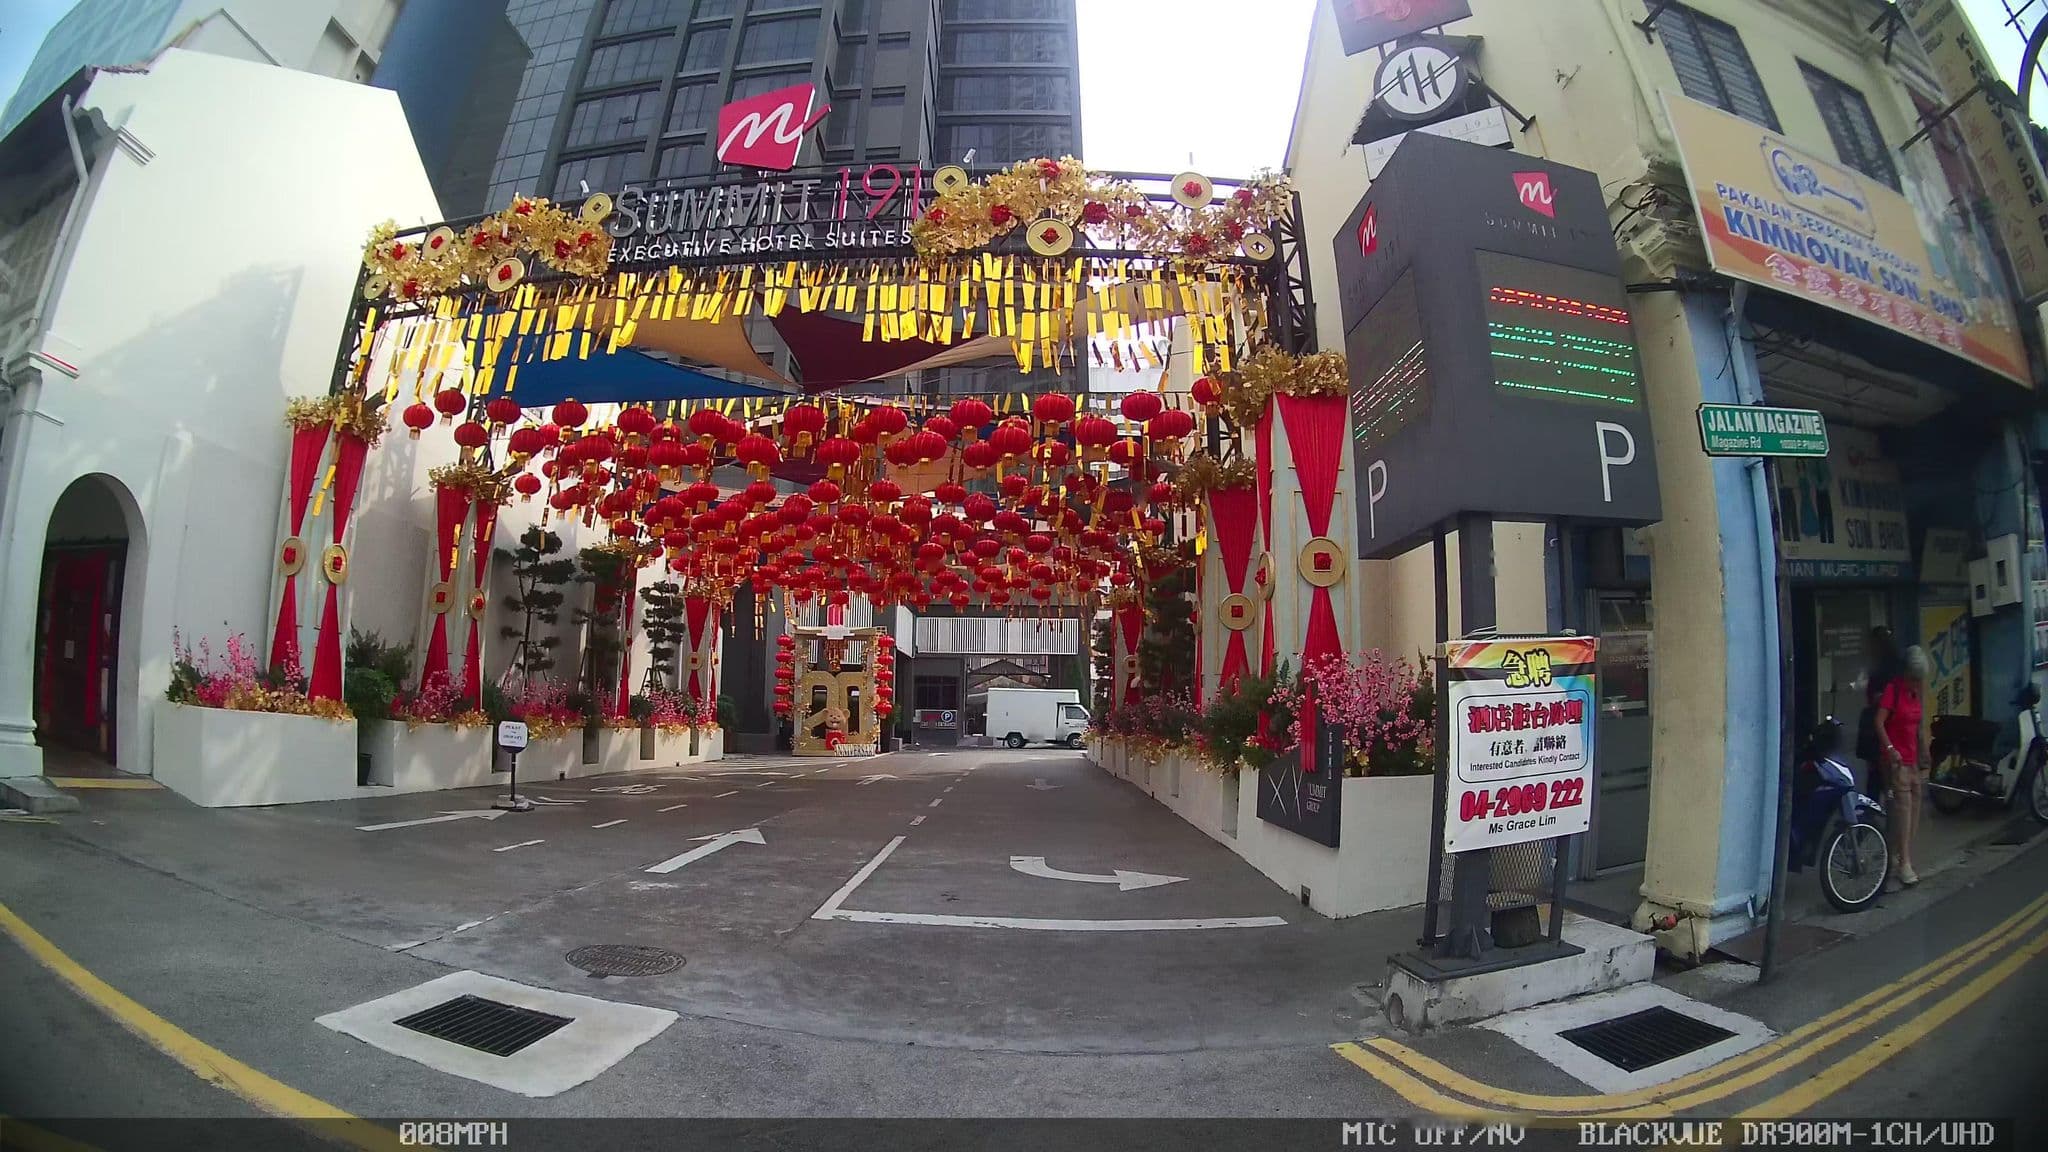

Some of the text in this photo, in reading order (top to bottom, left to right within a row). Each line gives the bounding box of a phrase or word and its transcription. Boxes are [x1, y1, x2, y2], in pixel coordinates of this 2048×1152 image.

[609, 163, 921, 239] SUMMIT 191
[1716, 182, 1793, 221] PAKAIAN
[607, 229, 913, 264] EXECUTIVE HOTEL SUITES
[1723, 205, 1875, 285] KIMNOVAK
[1708, 410, 1822, 435] JALAN MAGAZINE
[1711, 435, 1749, 450] Magazine
[1750, 436, 1762, 449] Rd
[1595, 420, 1637, 503] P
[1366, 458, 1389, 541] P
[1502, 648, 1553, 689] 急聘
[1469, 752, 1581, 773] Interested Candidates Kindly Contact
[1549, 777, 1584, 811] 222
[1488, 814, 1557, 835] Ms Grace Lim
